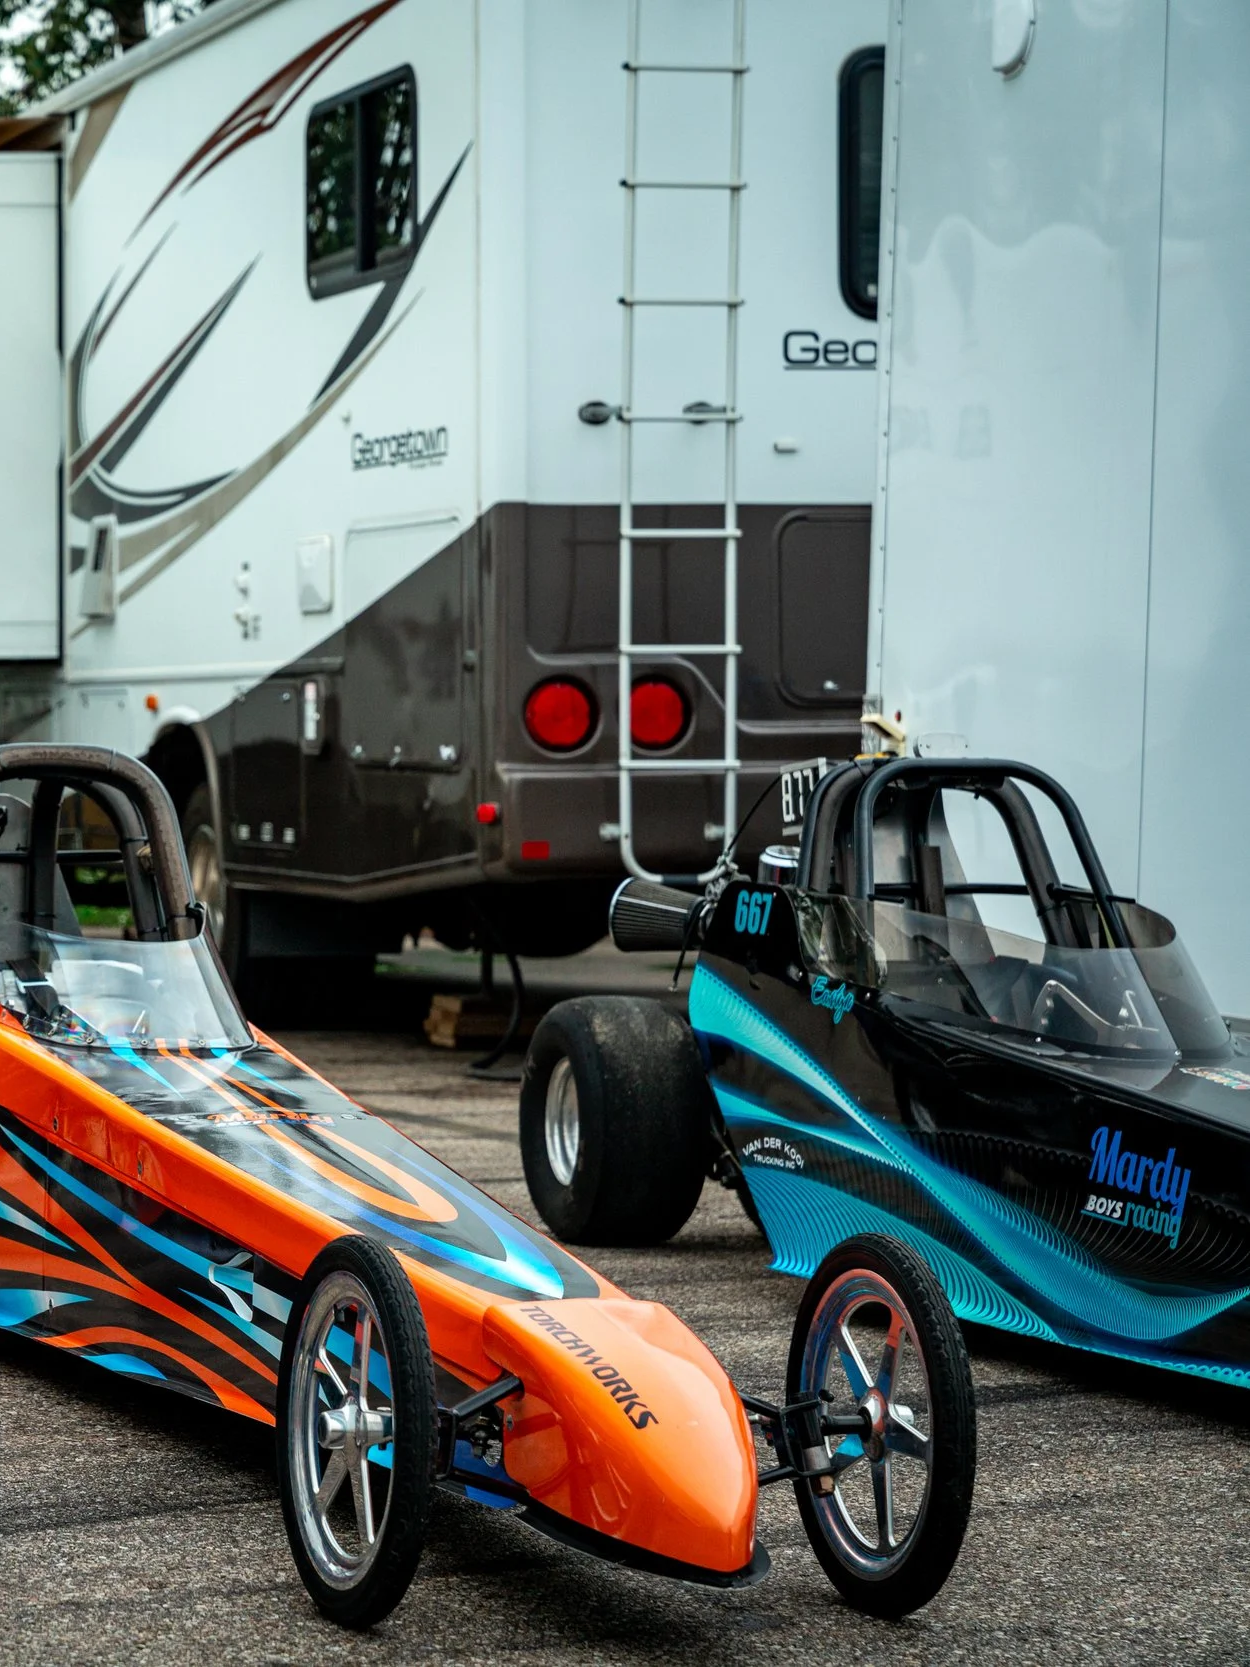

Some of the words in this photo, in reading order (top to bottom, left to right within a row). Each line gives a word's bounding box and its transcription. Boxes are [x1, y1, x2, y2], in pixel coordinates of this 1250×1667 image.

[352, 426, 448, 469] Georgetown
[734, 889, 773, 936] 667
[742, 1138, 762, 1156] VAN
[763, 1136, 782, 1151] DER
[783, 1143, 804, 1169] KOOI
[753, 1153, 784, 1168] TRUCKING
[785, 1160, 796, 1170] INC
[1089, 1125, 1191, 1218] Mardy
[1084, 1194, 1123, 1219] BOYS
[1123, 1200, 1182, 1250] racing
[520, 1305, 659, 1430] TORCHWORKS
